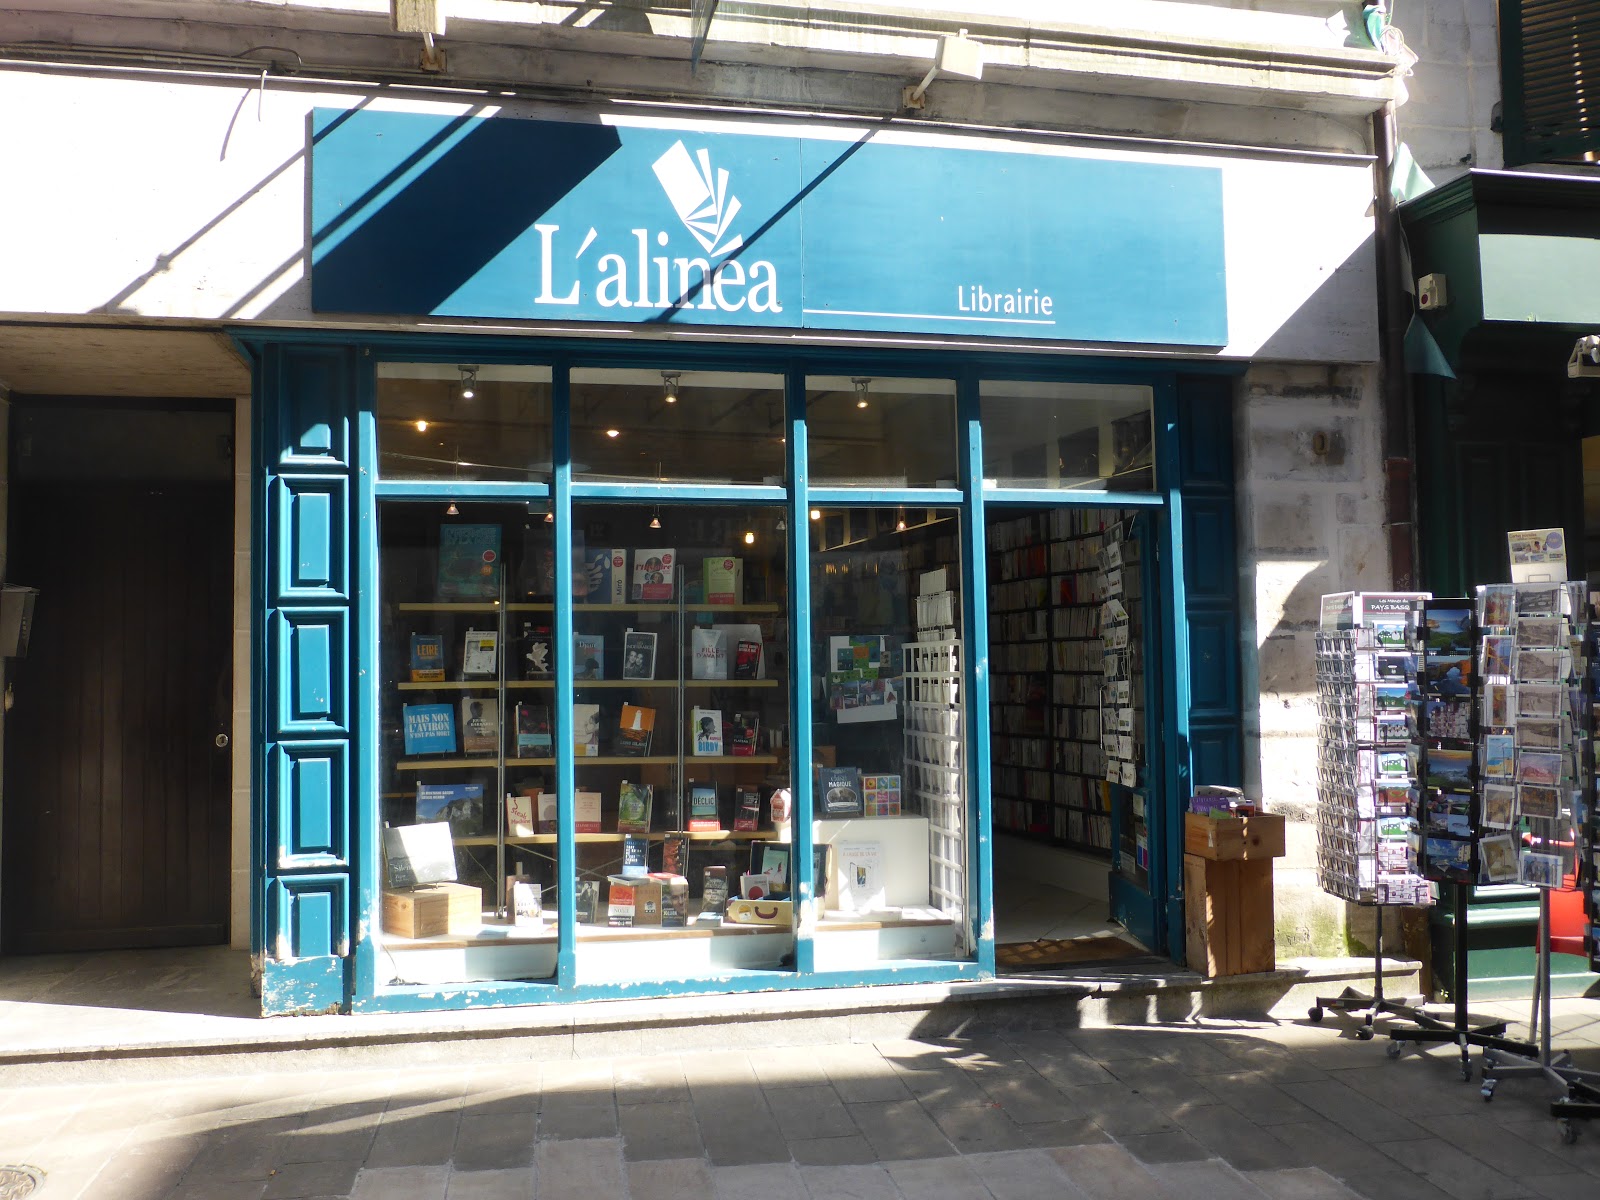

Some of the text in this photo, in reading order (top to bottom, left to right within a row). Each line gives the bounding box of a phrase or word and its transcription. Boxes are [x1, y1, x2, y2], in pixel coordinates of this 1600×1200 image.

[957, 284, 1054, 316] Librairie
[408, 713, 449, 723] MAIS NON
[409, 721, 450, 732] L'AVIRON
[698, 741, 719, 752] BIRDY
